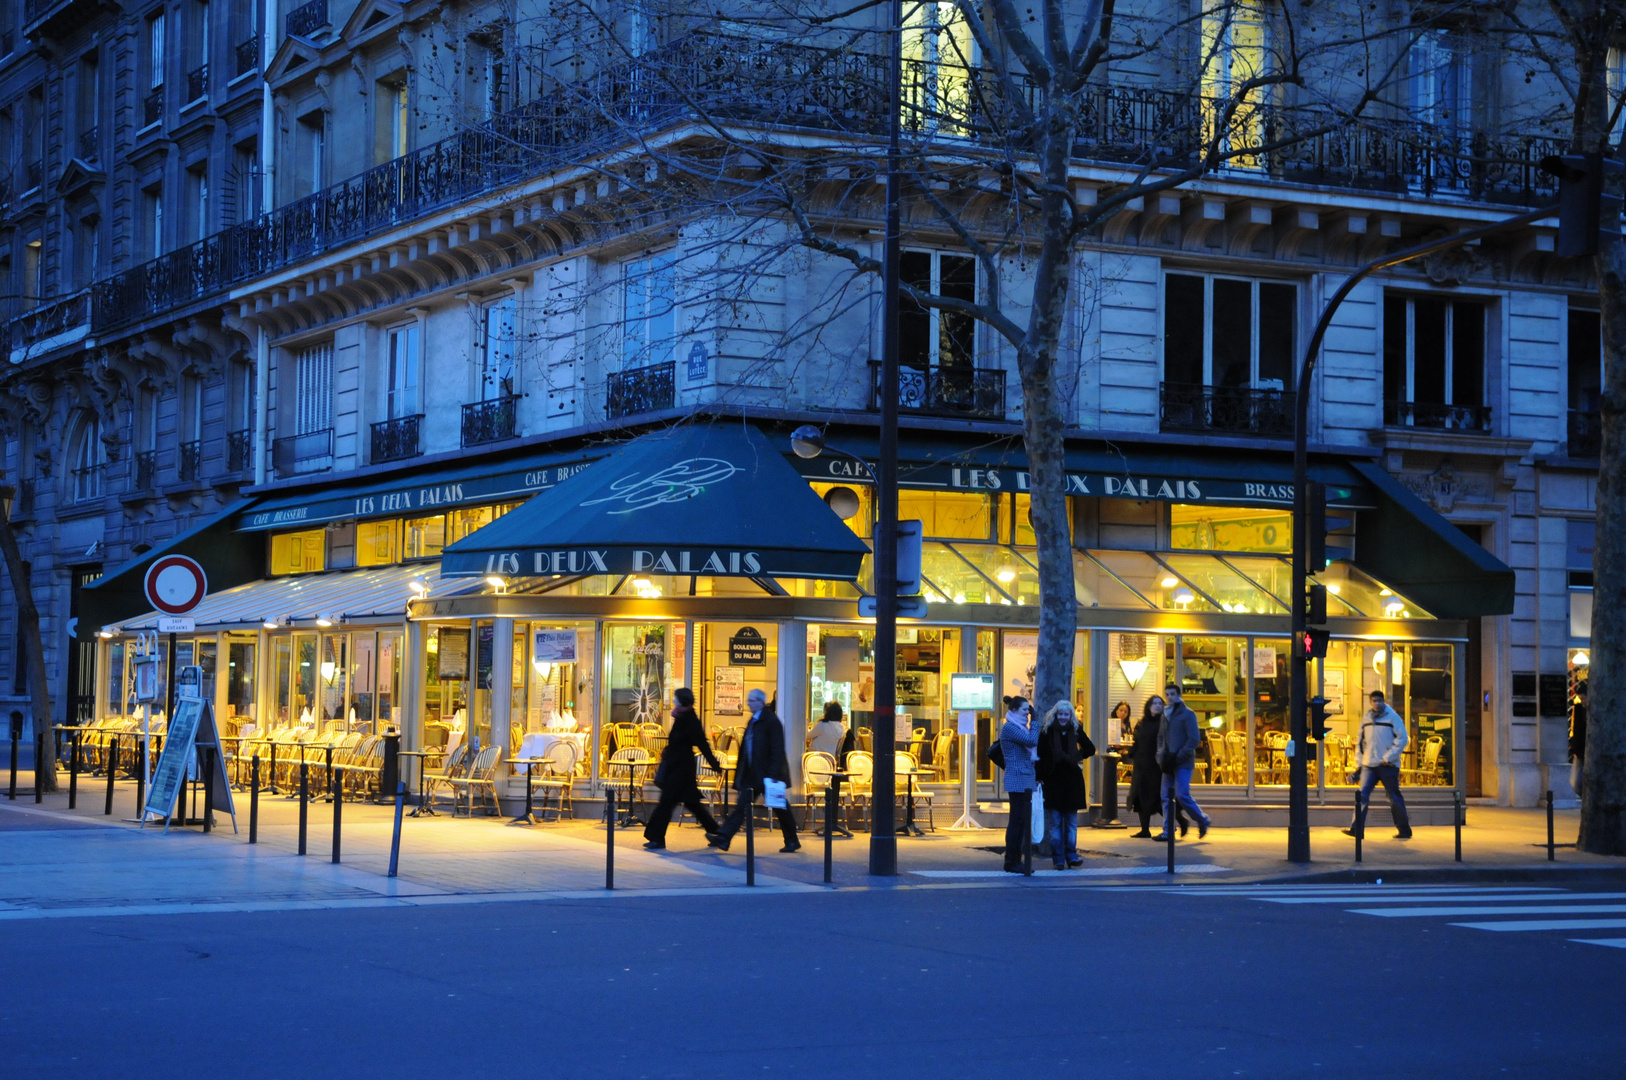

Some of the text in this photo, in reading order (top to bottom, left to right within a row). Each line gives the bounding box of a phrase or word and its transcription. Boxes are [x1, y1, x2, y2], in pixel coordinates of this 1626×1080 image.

[525, 470, 548, 486] CAFE
[829, 460, 876, 477] CAFE
[952, 468, 1201, 500] LES DX PALAIS
[355, 483, 463, 515] LES DEUX PALAIS
[253, 507, 307, 525] CAFE BRASSERIE
[485, 550, 761, 574] LES DEUX PALAIS
